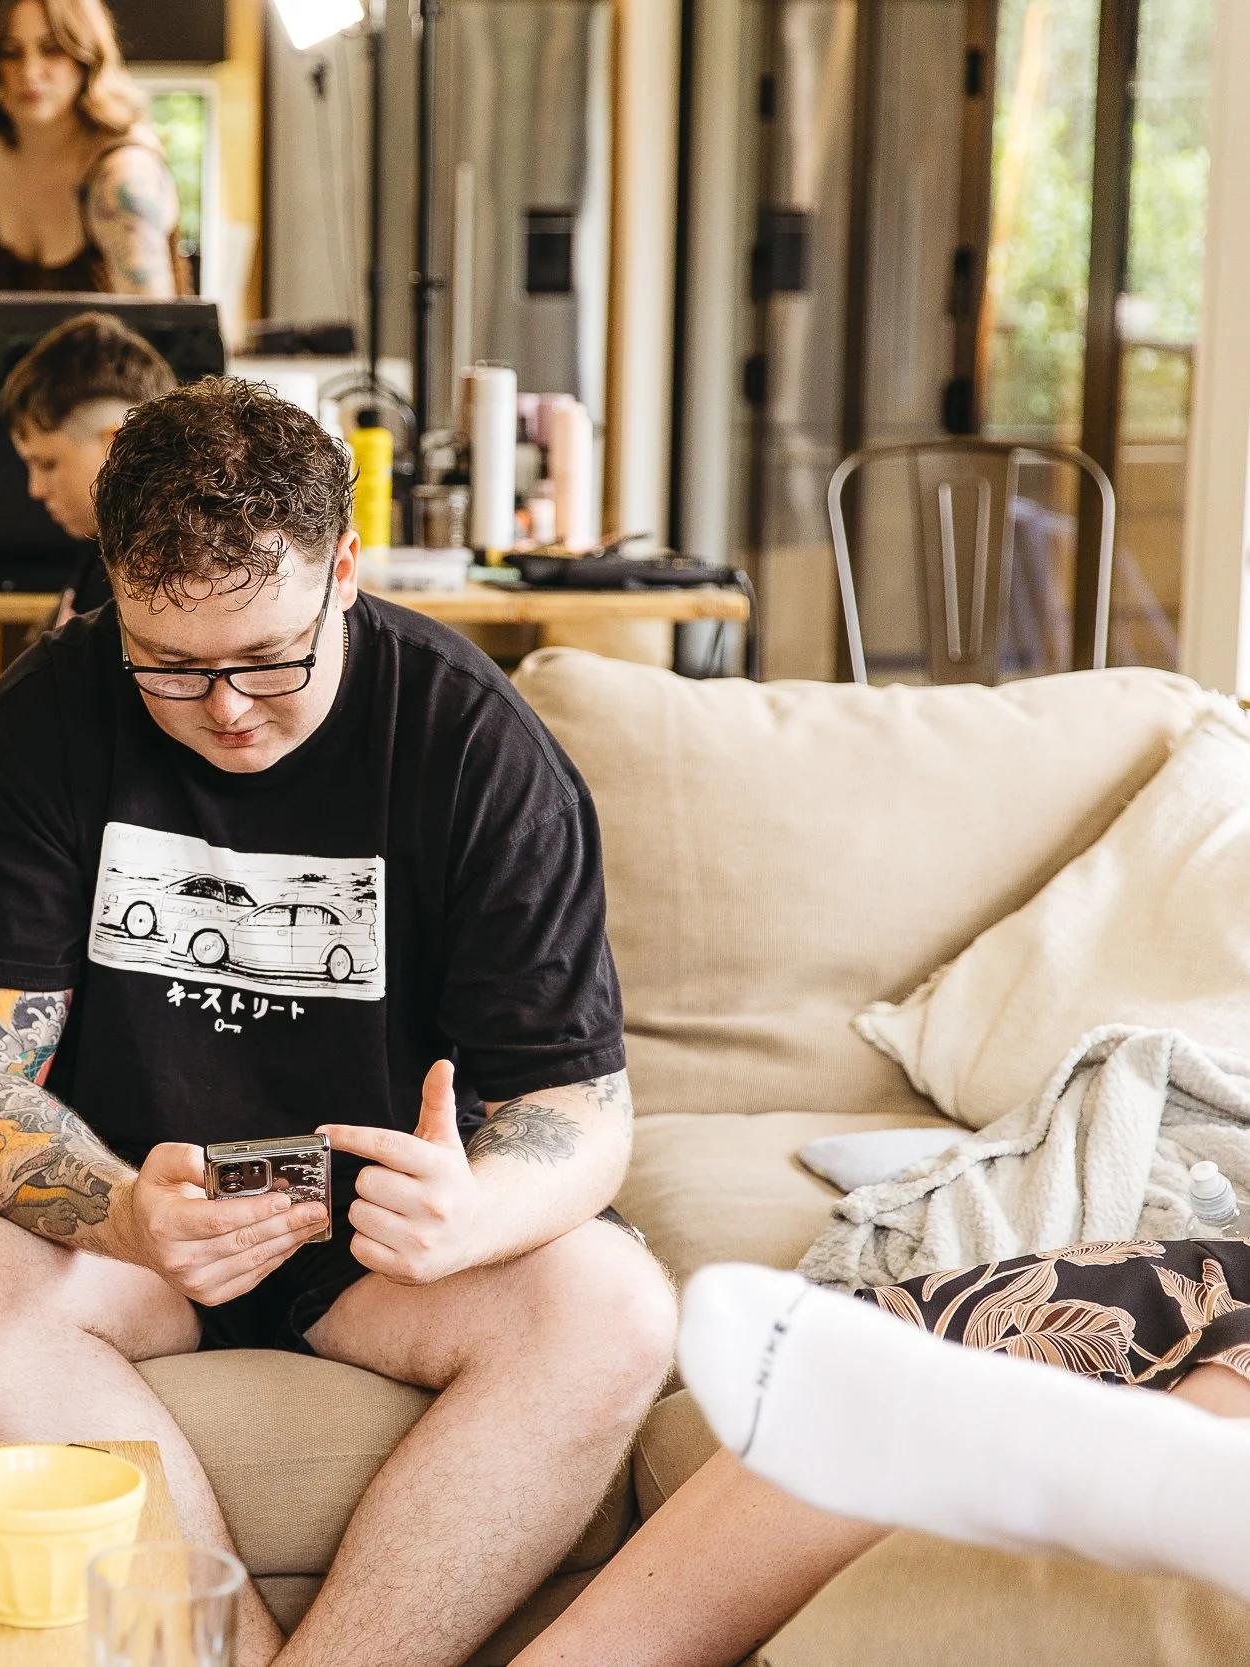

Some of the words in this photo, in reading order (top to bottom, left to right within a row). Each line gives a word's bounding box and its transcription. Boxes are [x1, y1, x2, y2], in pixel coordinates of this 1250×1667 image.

[166, 981, 305, 1020] キーストリート
